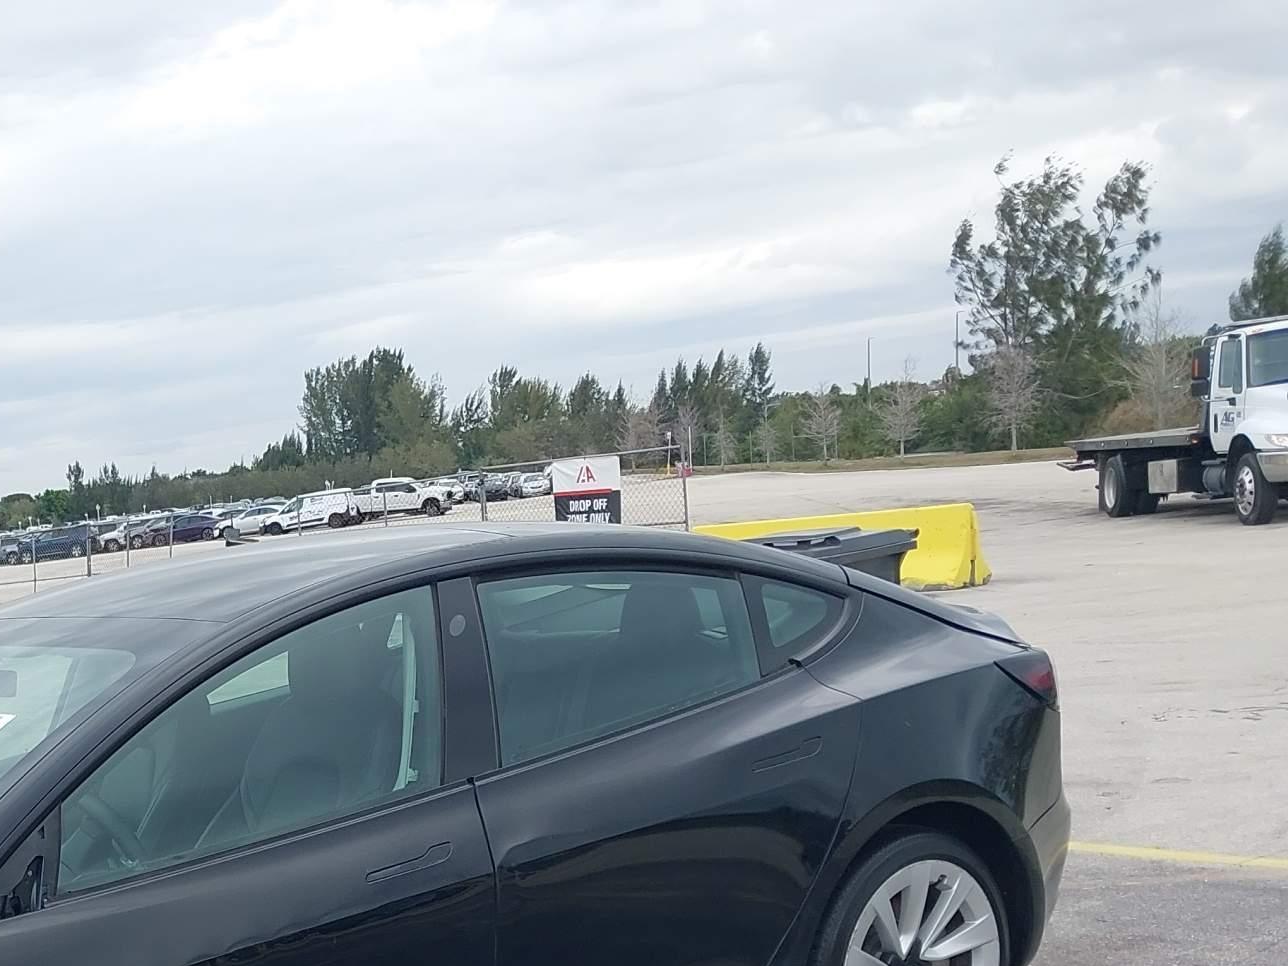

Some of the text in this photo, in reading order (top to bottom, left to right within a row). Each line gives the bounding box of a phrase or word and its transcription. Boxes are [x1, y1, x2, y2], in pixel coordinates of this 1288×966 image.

[569, 498, 608, 512] DROP OFF
[566, 511, 611, 524] ZONE ONLY
